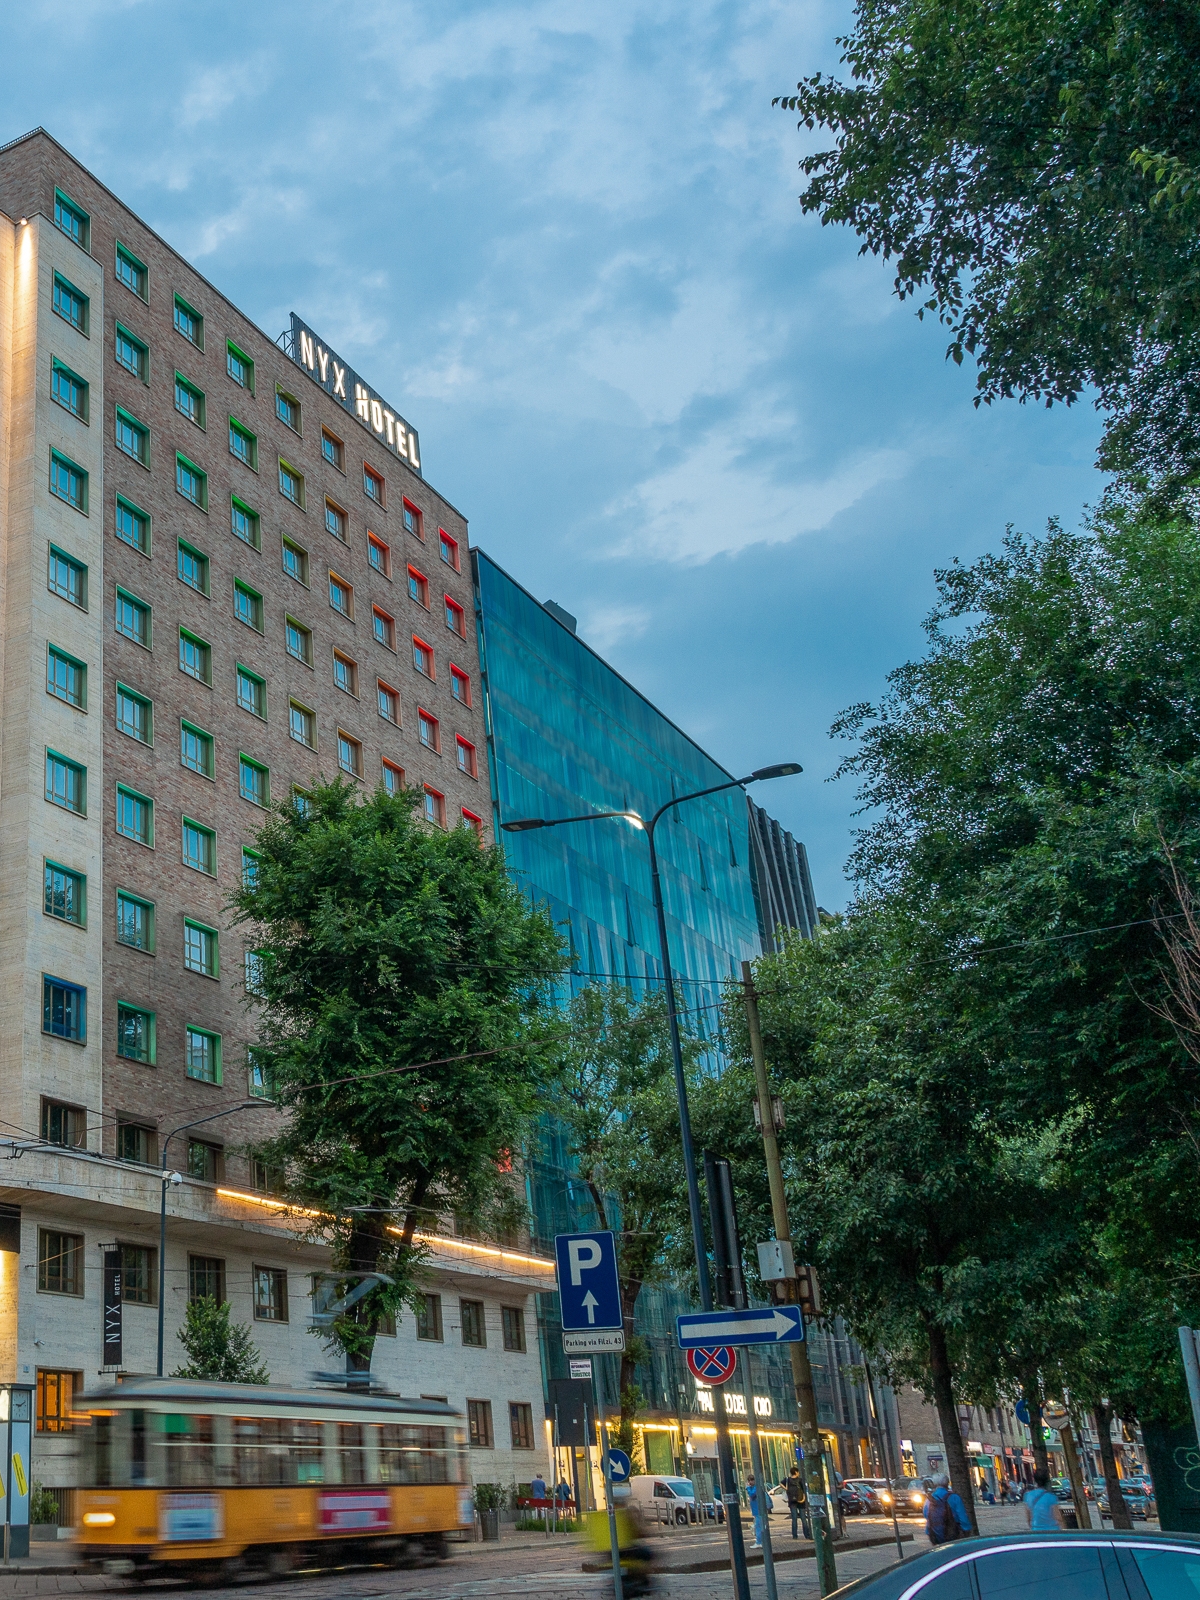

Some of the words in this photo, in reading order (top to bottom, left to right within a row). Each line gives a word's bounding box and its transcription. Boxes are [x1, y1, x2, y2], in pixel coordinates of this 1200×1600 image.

[300, 331, 346, 400] NYX
[355, 383, 420, 469] HOTEL
[567, 1238, 602, 1286] P
[105, 1304, 121, 1343] NYX
[565, 1339, 587, 1347] Parking
[588, 1338, 597, 1346] via
[613, 1336, 622, 1345] 43
